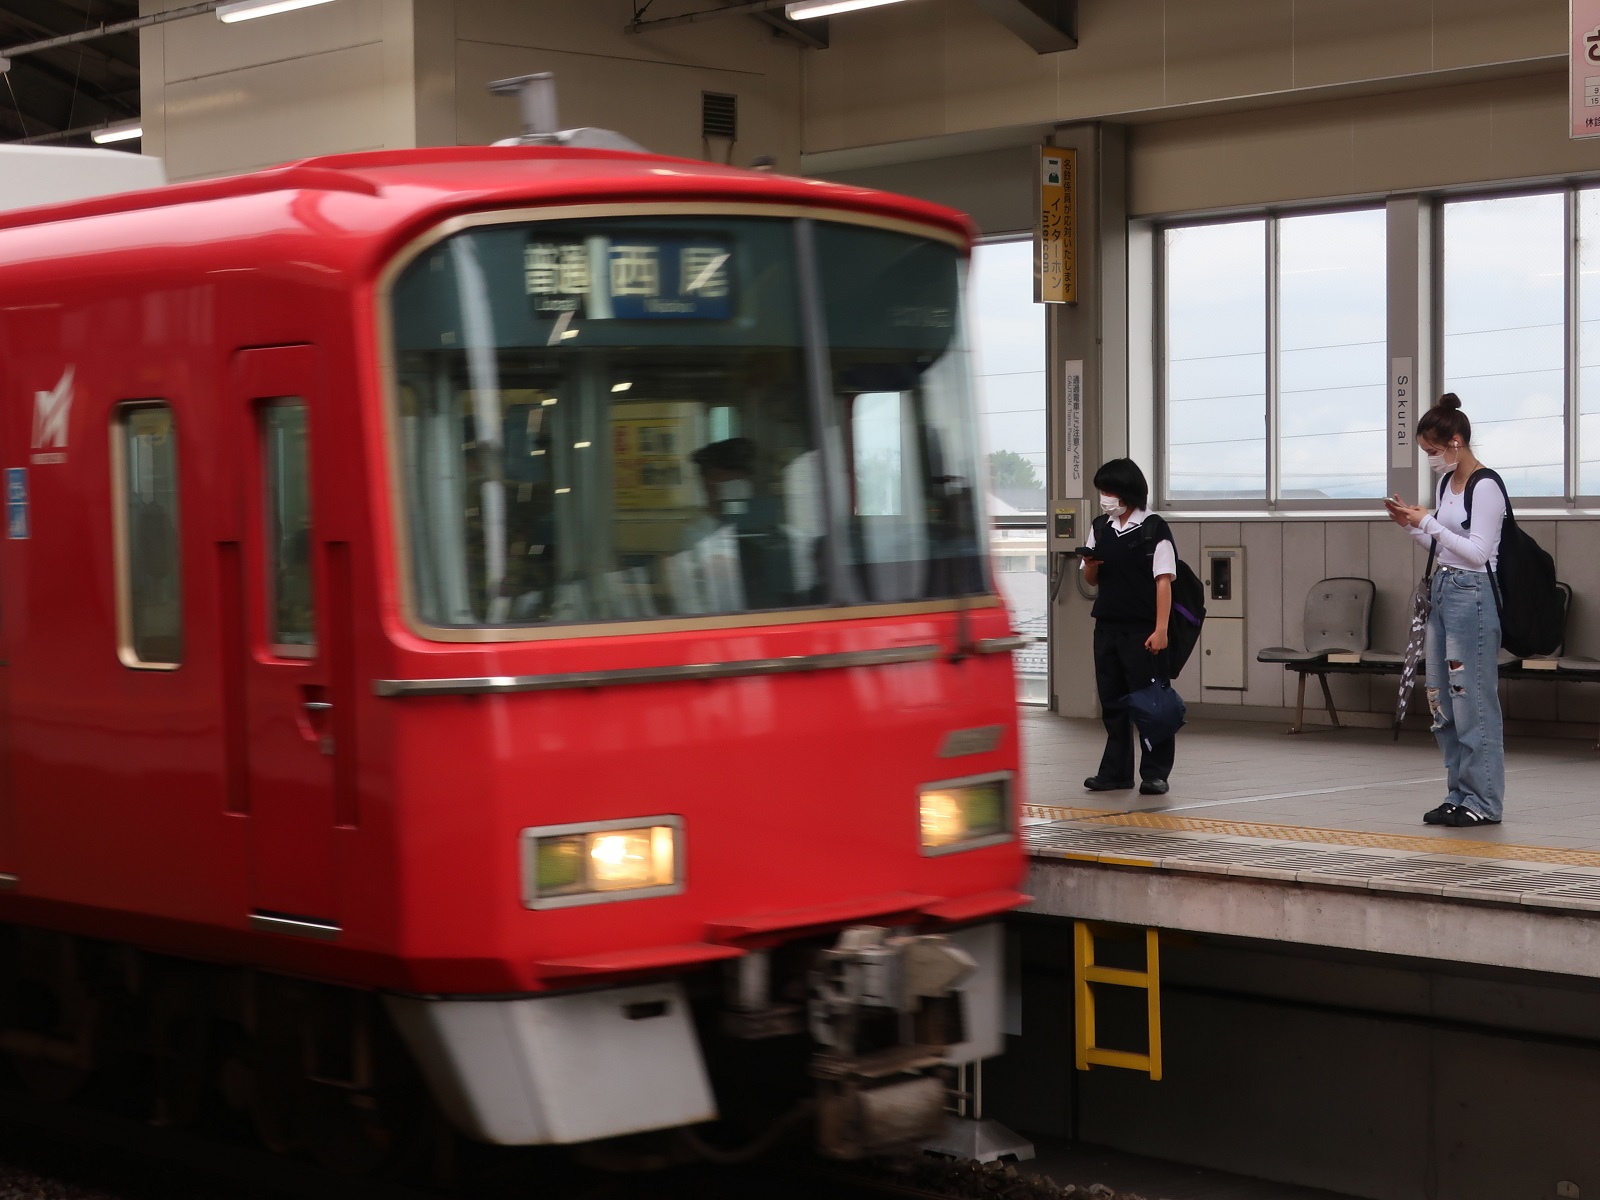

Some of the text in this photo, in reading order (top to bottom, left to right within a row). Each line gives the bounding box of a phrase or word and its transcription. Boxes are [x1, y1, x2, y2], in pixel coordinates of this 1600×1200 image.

[1591, 97, 1599, 105] 15
[1051, 198, 1061, 288] インターホン
[1063, 159, 1071, 293] 名鉄係員が応対いたします
[1397, 375, 1409, 446] Sakurai
